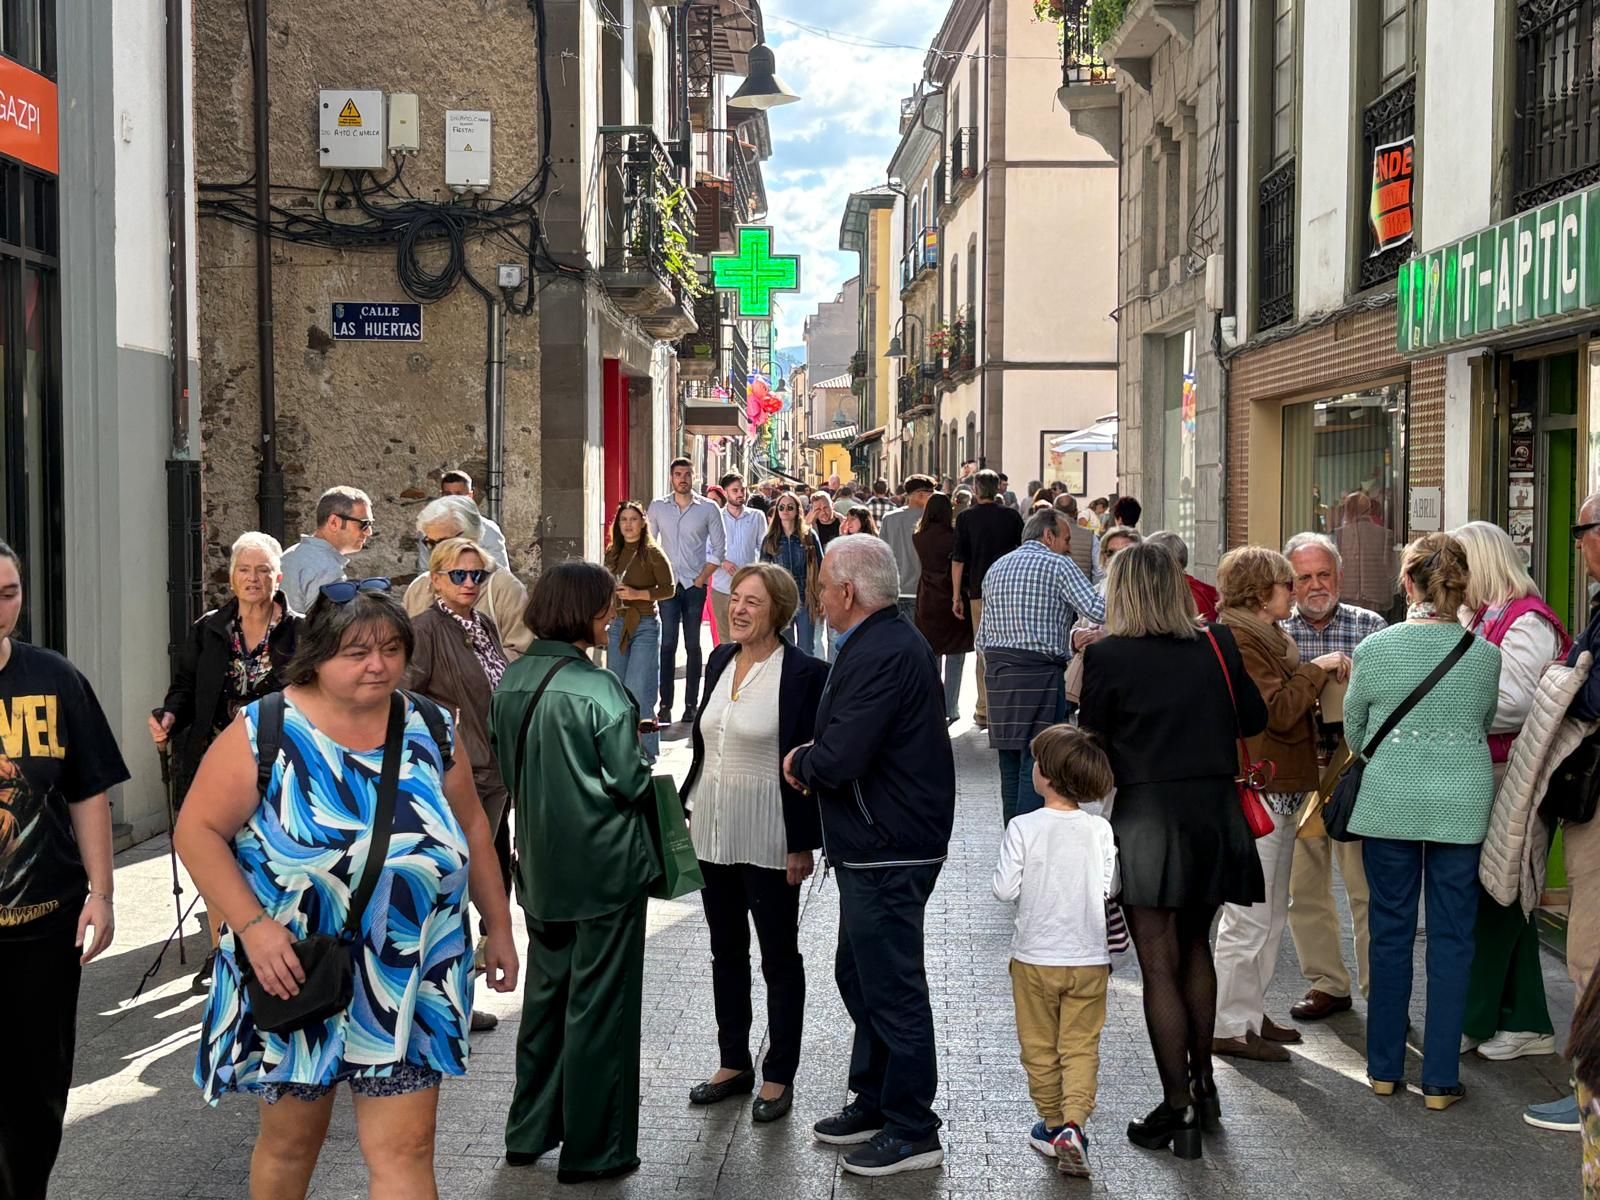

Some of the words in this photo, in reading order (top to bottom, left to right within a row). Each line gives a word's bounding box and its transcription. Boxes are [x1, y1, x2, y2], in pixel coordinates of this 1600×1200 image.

[1376, 146, 1413, 184] NDE
[361, 306, 400, 317] CALLE
[333, 321, 356, 336] LAS
[365, 322, 420, 337] HUERTAS
[1412, 497, 1437, 518] ABRIL
